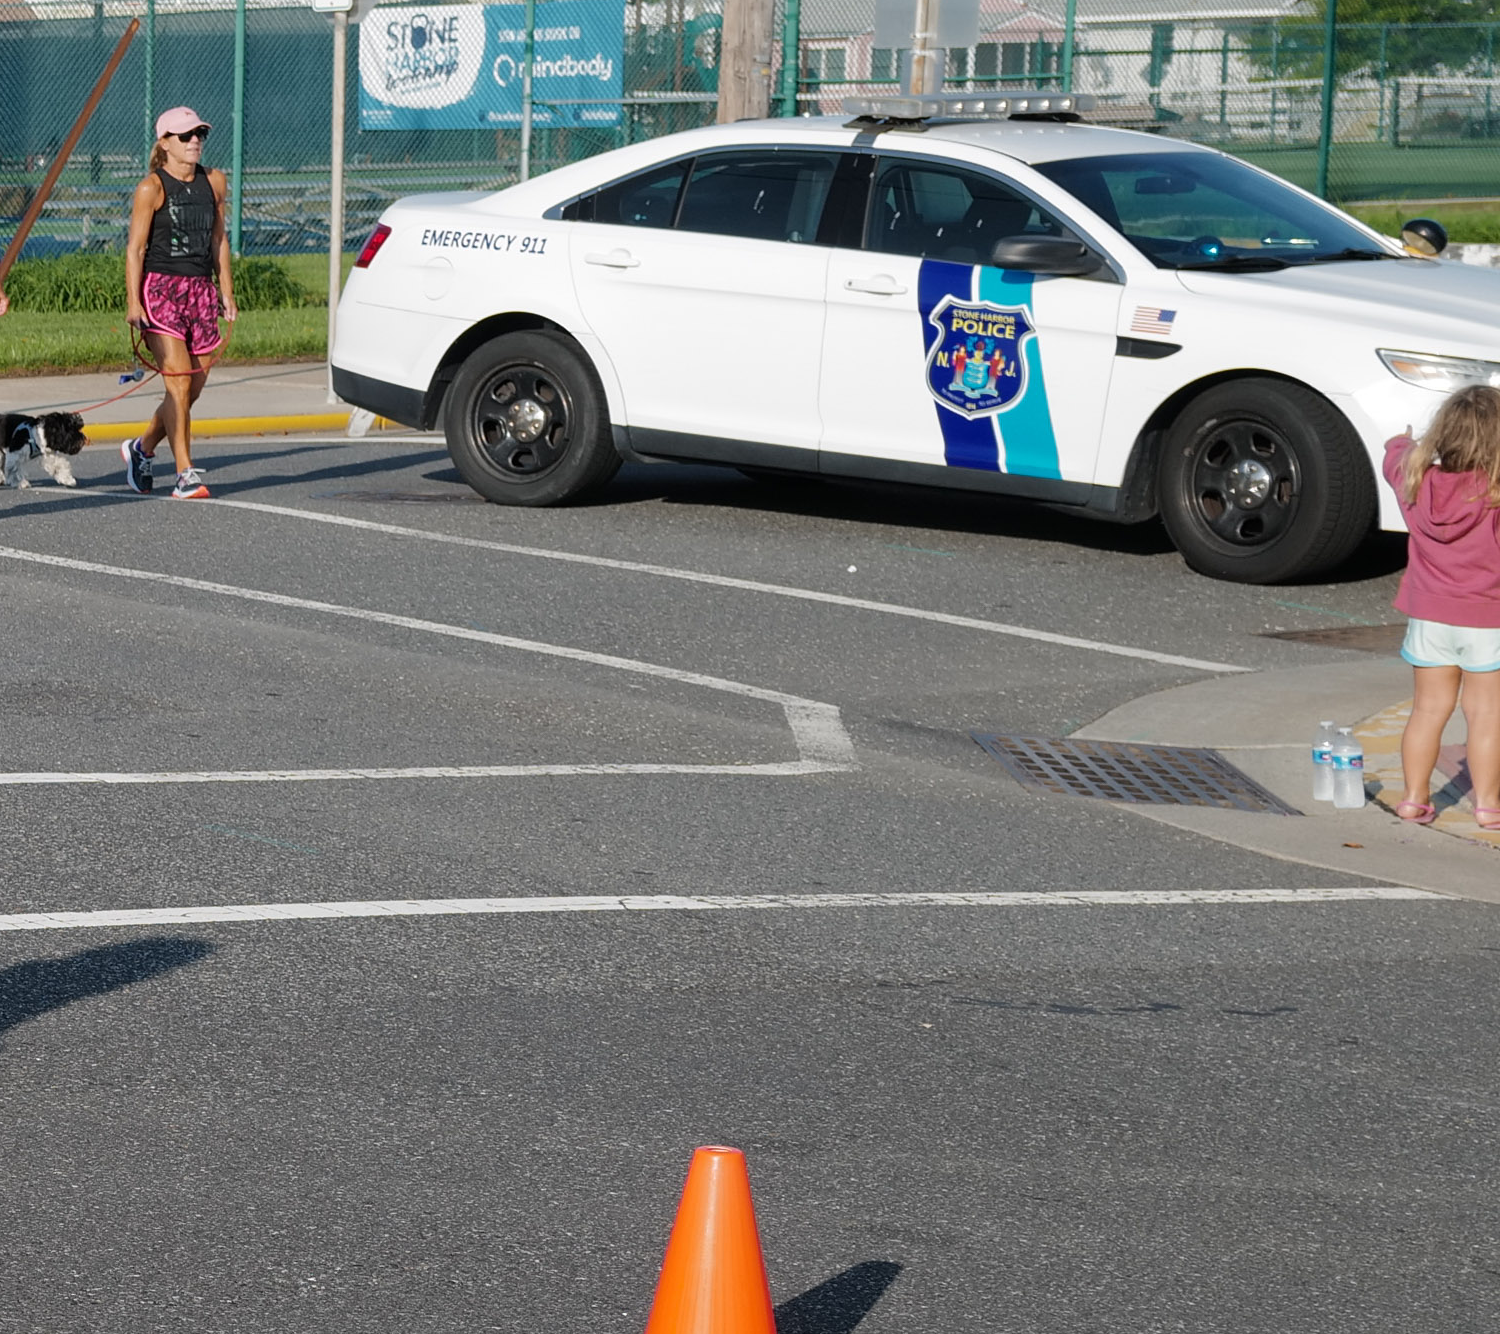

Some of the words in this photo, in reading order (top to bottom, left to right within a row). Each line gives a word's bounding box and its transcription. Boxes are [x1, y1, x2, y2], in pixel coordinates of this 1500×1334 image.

[421, 230, 516, 251] EMERGENCY
[520, 237, 547, 254] 911
[953, 309, 979, 320] STONE
[981, 313, 1015, 324] HARBOR
[952, 319, 1015, 339] POLICE
